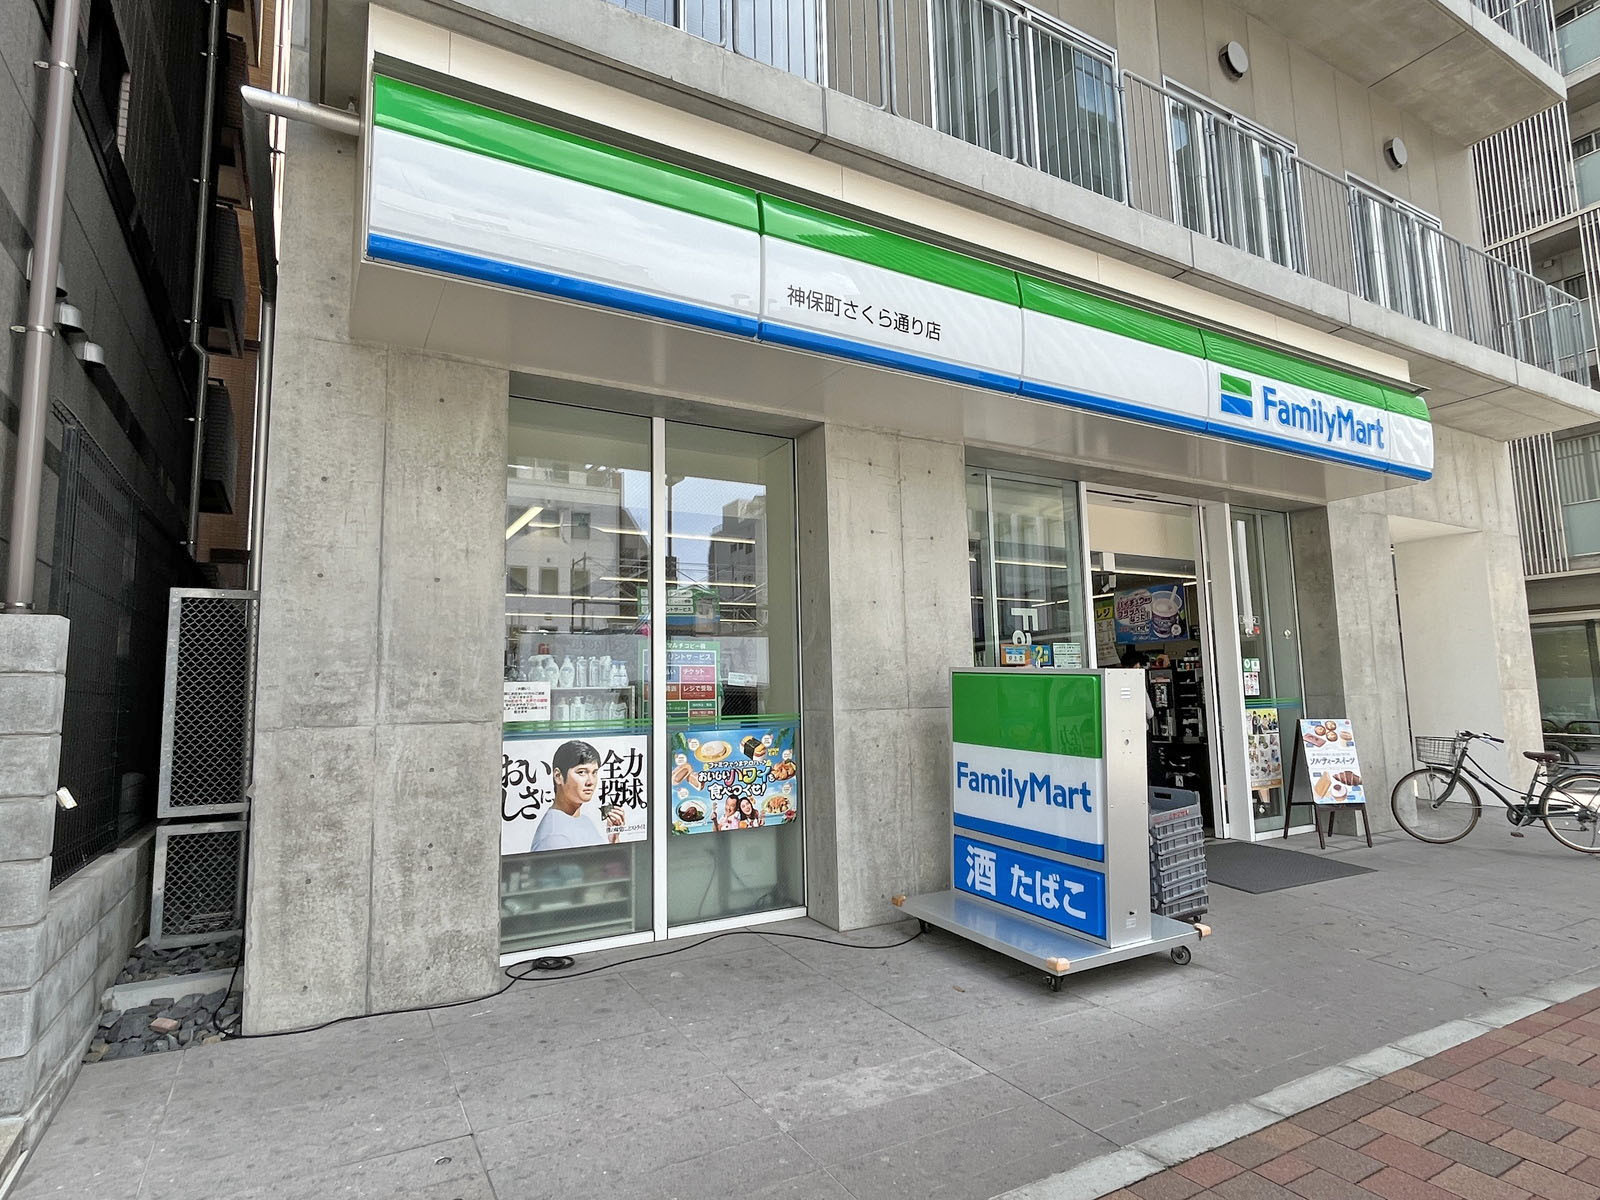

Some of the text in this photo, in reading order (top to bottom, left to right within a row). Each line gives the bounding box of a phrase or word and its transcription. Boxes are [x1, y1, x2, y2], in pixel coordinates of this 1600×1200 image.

[787, 284, 941, 341] 神保町さくら通り店
[1262, 385, 1385, 449] FamilyMart
[599, 747, 644, 781] 全力
[956, 761, 1093, 813] FamilyMart
[1310, 757, 1356, 766] ソルティースイーツ
[965, 844, 1087, 920] 酒 たばこ
